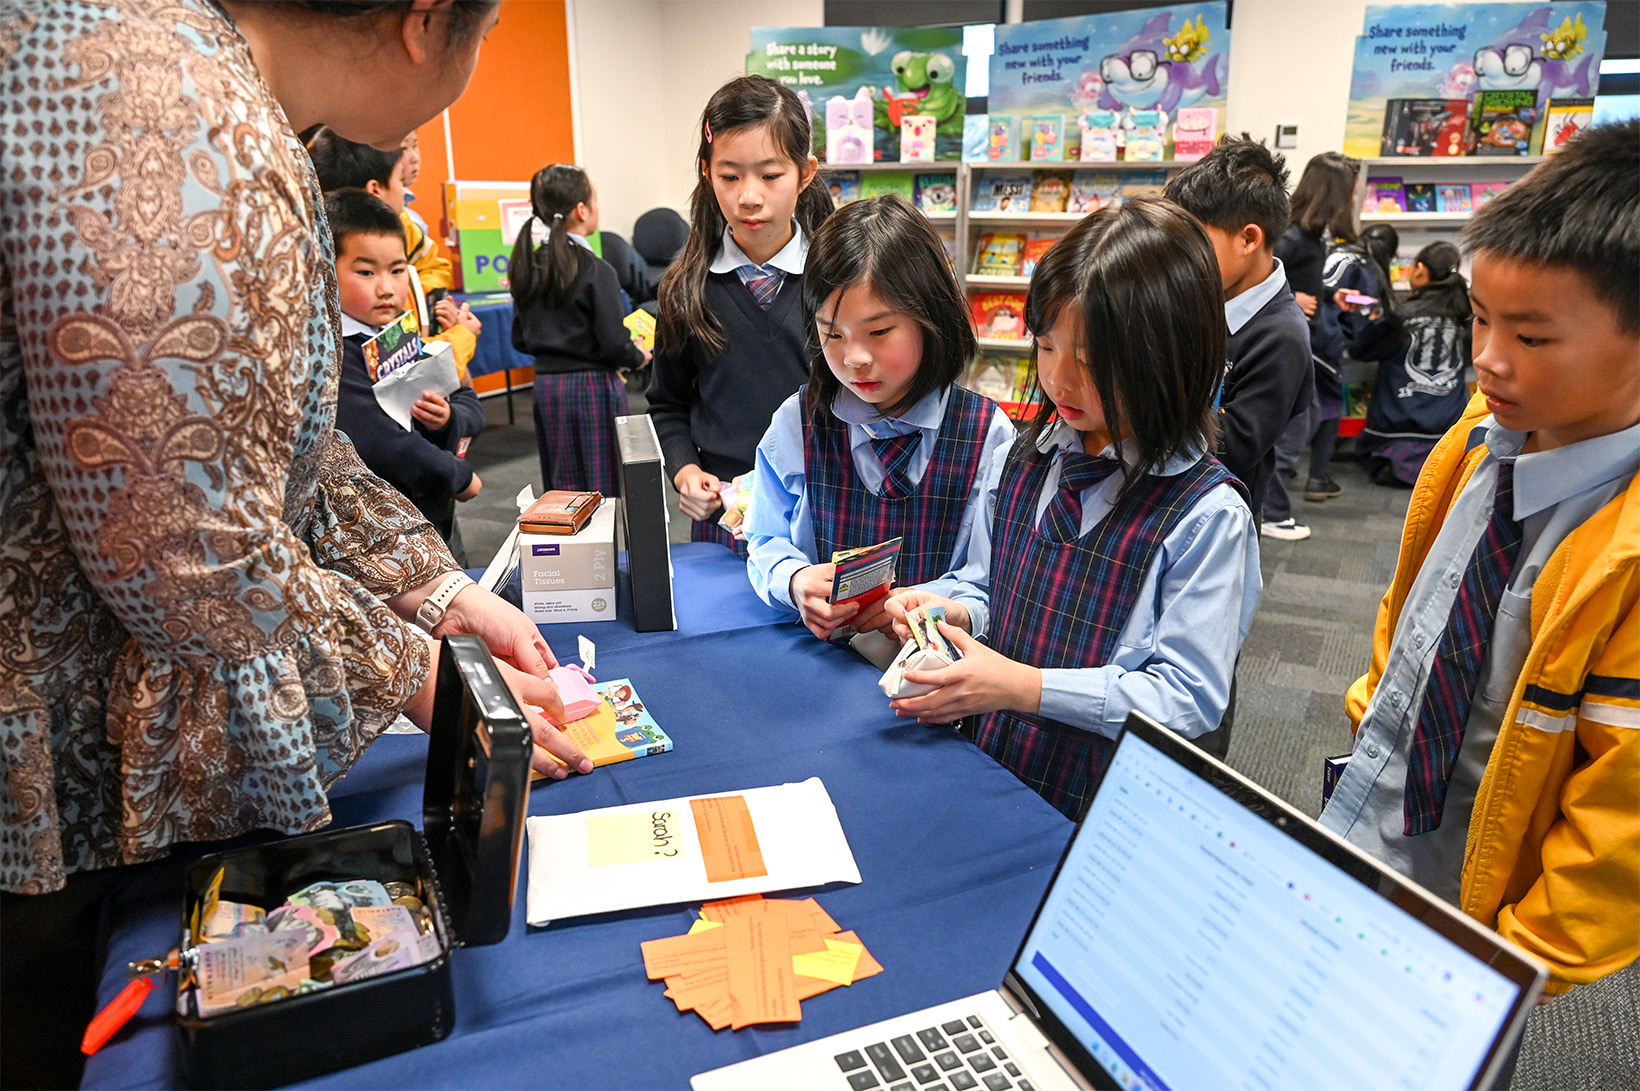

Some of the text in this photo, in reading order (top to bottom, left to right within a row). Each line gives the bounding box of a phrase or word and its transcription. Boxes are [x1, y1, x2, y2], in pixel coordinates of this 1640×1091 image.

[1369, 22, 1467, 41] Share something
[766, 41, 838, 60] Share a story
[998, 35, 1090, 56] Share something
[1374, 40, 1457, 59] new with your
[766, 56, 837, 71] with someone
[1005, 53, 1082, 70] new with your
[1391, 56, 1435, 72] friends.
[798, 70, 824, 85] love.
[1022, 69, 1064, 85] friends.
[376, 336, 418, 381] CRYSTALS
[533, 570, 561, 578] Facial
[594, 549, 607, 581] 2 Ply
